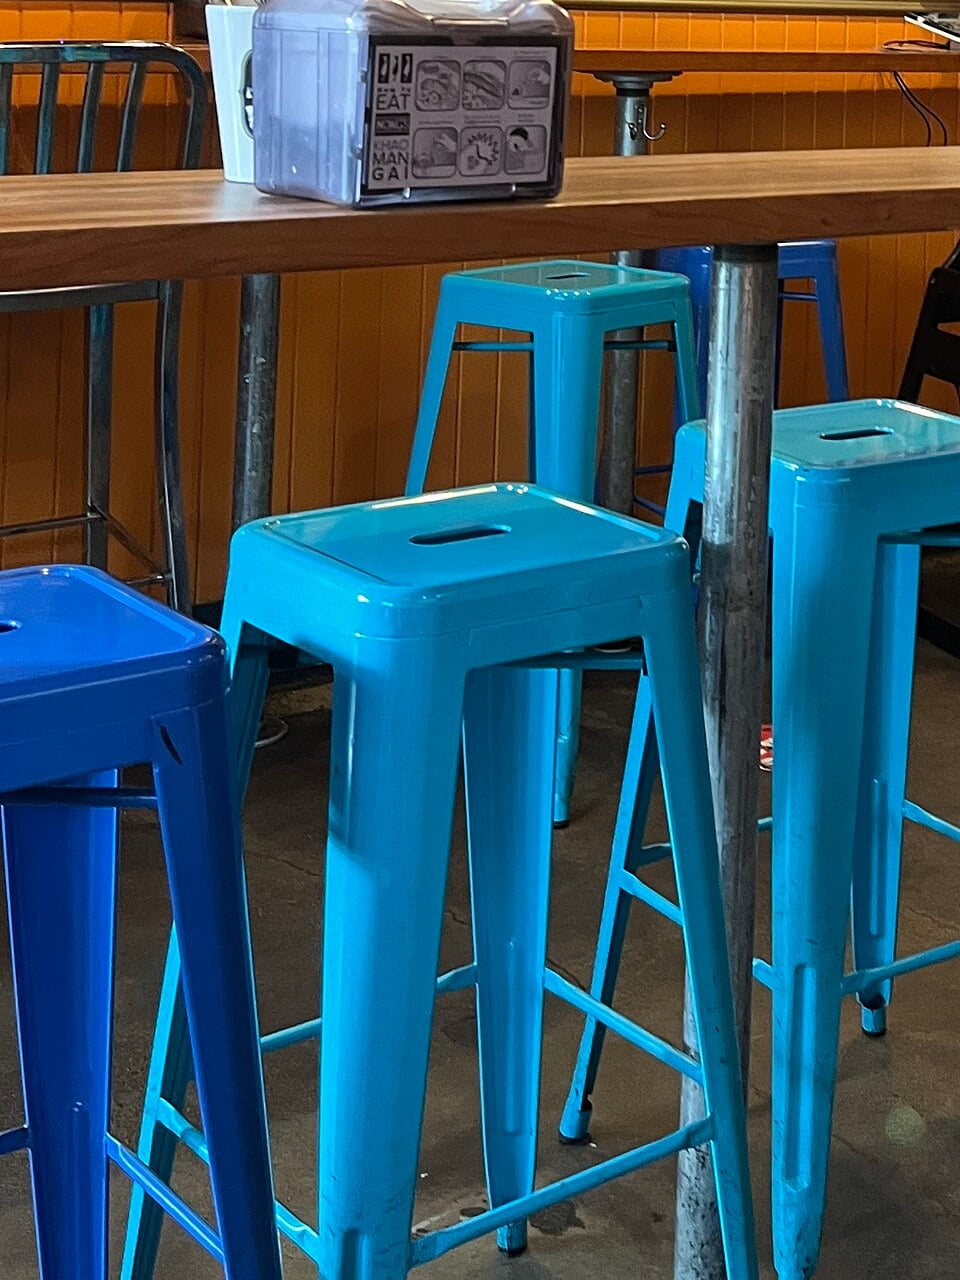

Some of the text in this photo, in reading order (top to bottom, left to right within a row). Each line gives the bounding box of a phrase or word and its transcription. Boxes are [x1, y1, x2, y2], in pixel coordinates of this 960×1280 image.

[376, 93, 411, 111] EAT
[373, 151, 409, 166] MAN
[372, 165, 408, 181] GAI
